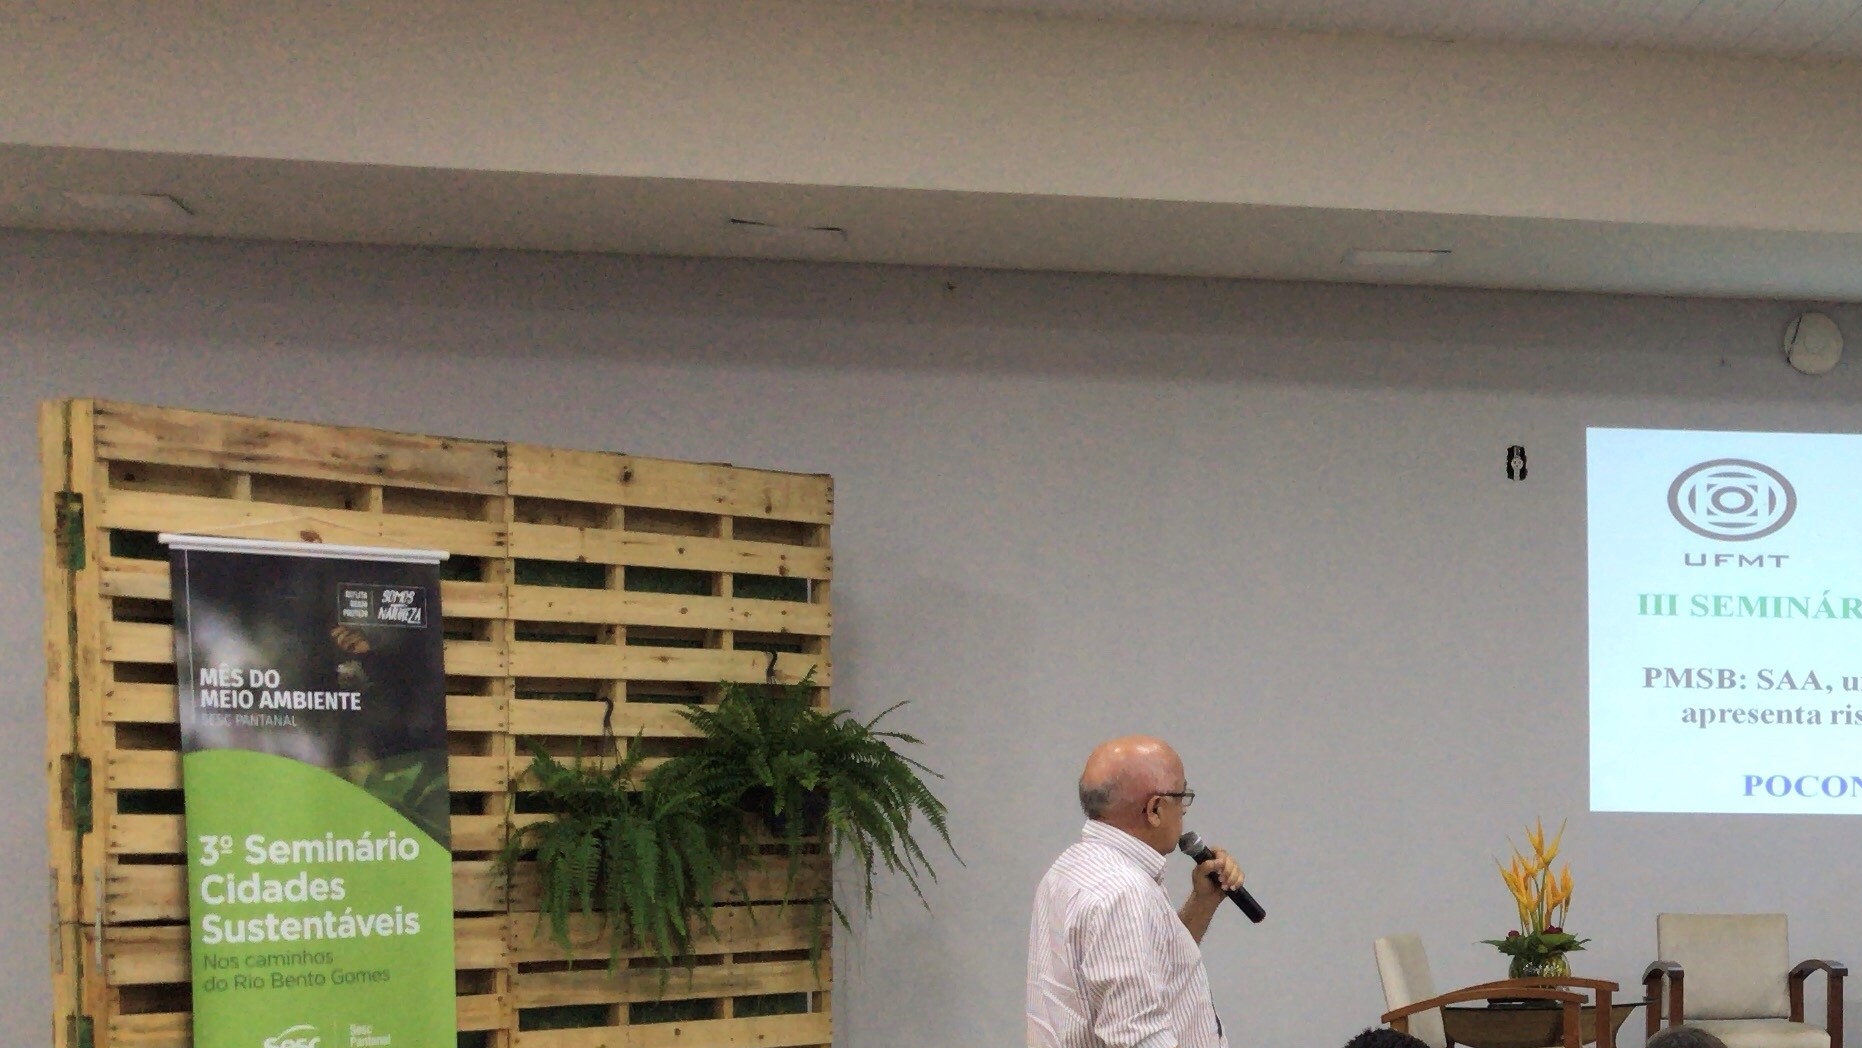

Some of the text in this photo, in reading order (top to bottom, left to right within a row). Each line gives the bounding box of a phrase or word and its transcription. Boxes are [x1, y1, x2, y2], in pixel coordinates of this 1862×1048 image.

[1684, 553, 1790, 568] UFMT
[1637, 594, 1680, 616] III
[200, 663, 281, 689] MÊS DO
[1642, 667, 1747, 690] PMSB:
[1757, 668, 1833, 694] SAA,
[200, 689, 362, 711] MEIO AMBIENTE
[1681, 706, 1822, 729] apresenta
[245, 831, 421, 865] Seminário
[201, 871, 346, 905] Cidades
[202, 905, 421, 945] Sustentáveis
[203, 950, 333, 970] Nos caminhos
[203, 967, 391, 992] do Rio Bento Gomes
